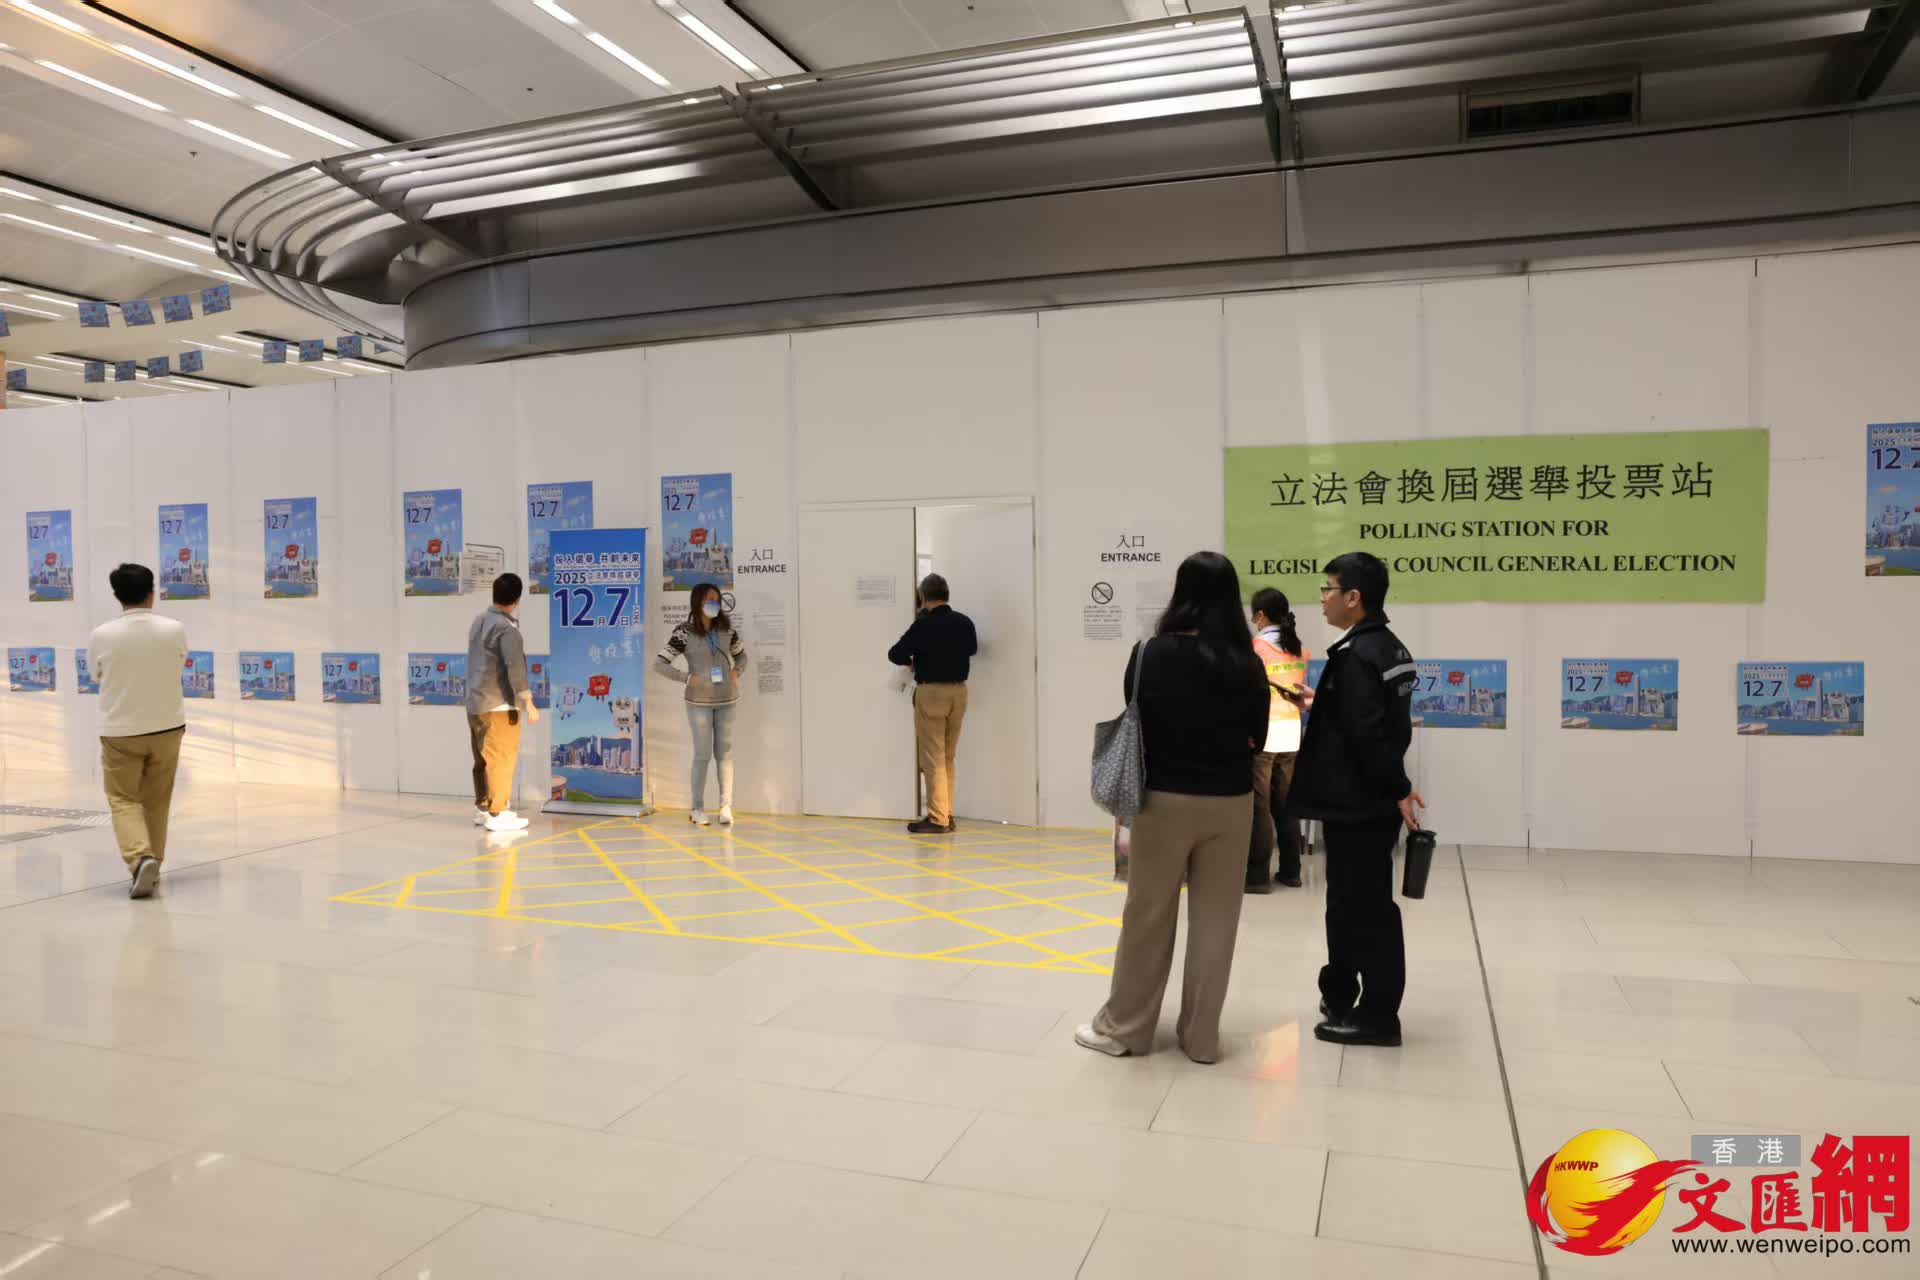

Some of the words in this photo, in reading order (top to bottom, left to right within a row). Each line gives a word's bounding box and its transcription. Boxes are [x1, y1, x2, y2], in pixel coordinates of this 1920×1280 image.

[1269, 461, 1714, 507] 立法會換屆選舉投票站
[1358, 521, 1457, 541] POLLING
[1461, 520, 1557, 538] STATION
[1561, 519, 1609, 537] FOR
[1116, 534, 1145, 549] 入口
[751, 548, 773, 561] 入口
[1100, 552, 1161, 563] ENTRANCE
[737, 564, 787, 574] ENTRANCE
[1249, 555, 1388, 575] LEGISL
[1393, 555, 1497, 573] COUNCIL
[1498, 555, 1608, 572] GENERAL
[1612, 553, 1737, 573] ELECTION
[555, 572, 587, 585] 2025
